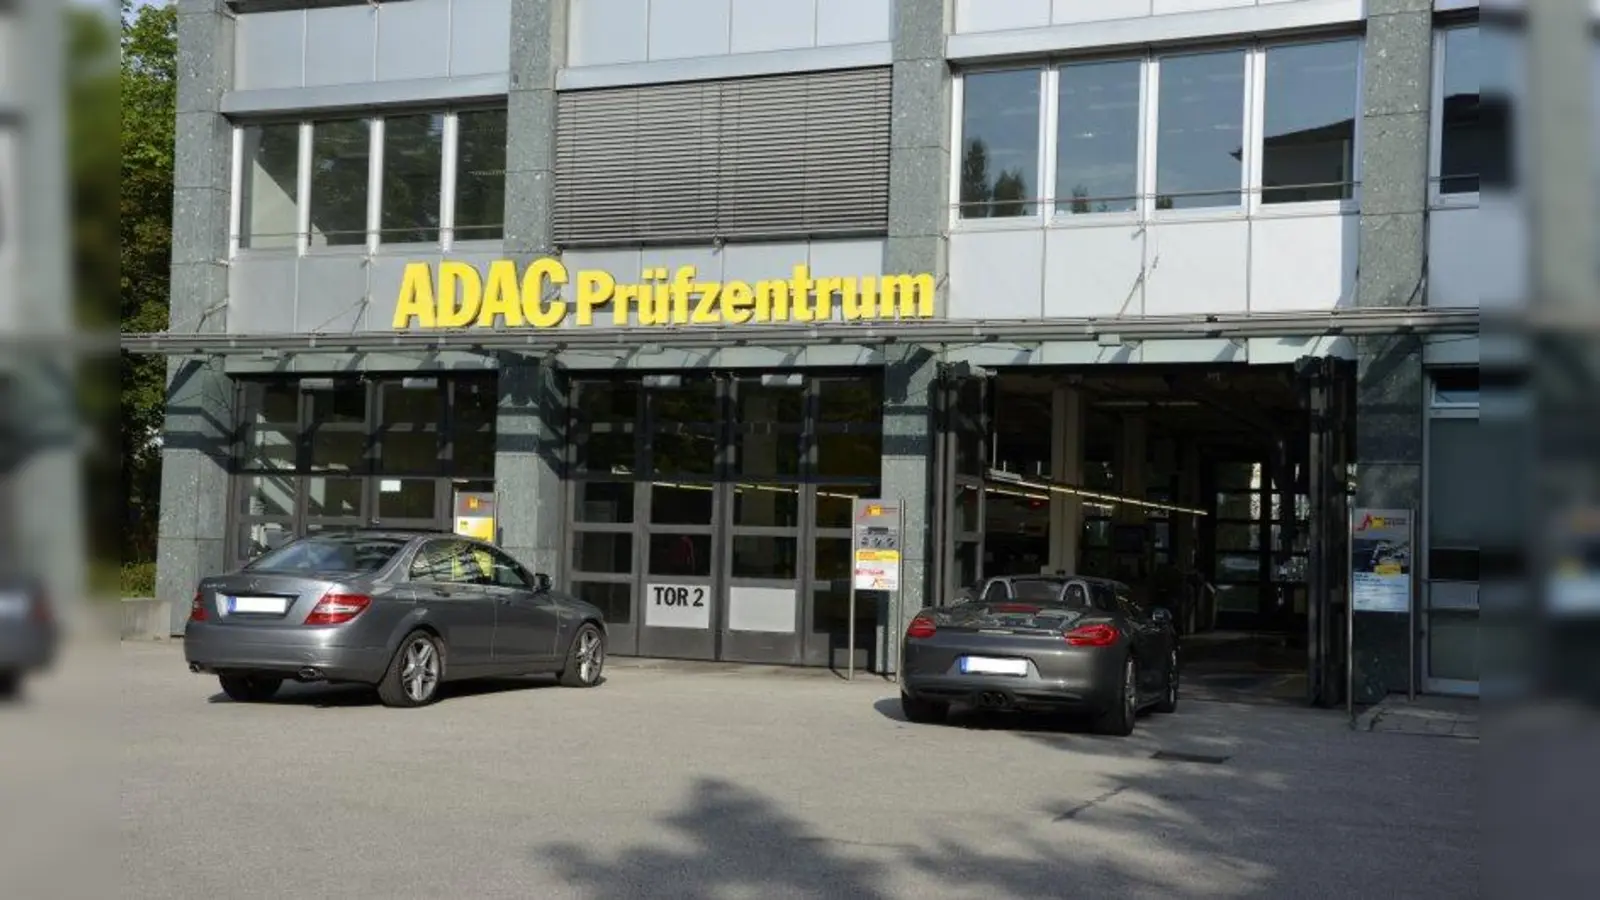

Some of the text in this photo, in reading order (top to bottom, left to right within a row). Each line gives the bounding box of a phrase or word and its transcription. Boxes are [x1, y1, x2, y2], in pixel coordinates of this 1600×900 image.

[393, 259, 934, 328] ADAC Prüfzentrum
[653, 586, 705, 608] TOR 2
